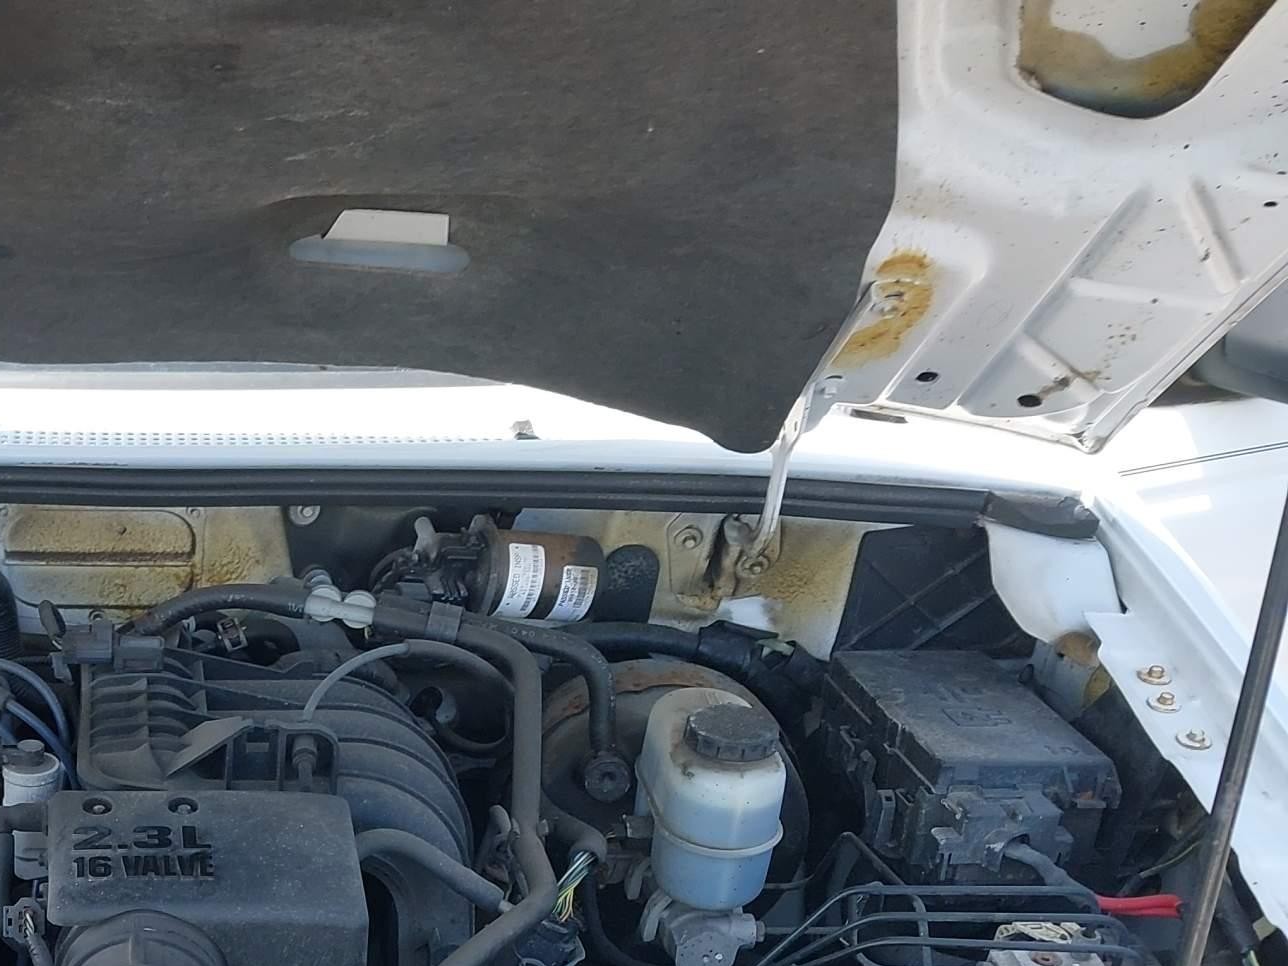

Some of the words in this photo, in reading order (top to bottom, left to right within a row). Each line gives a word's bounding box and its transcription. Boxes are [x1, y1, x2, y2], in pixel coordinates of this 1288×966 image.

[71, 825, 212, 851] 2.3L
[72, 854, 113, 879] 16
[120, 854, 216, 880] VALVE
